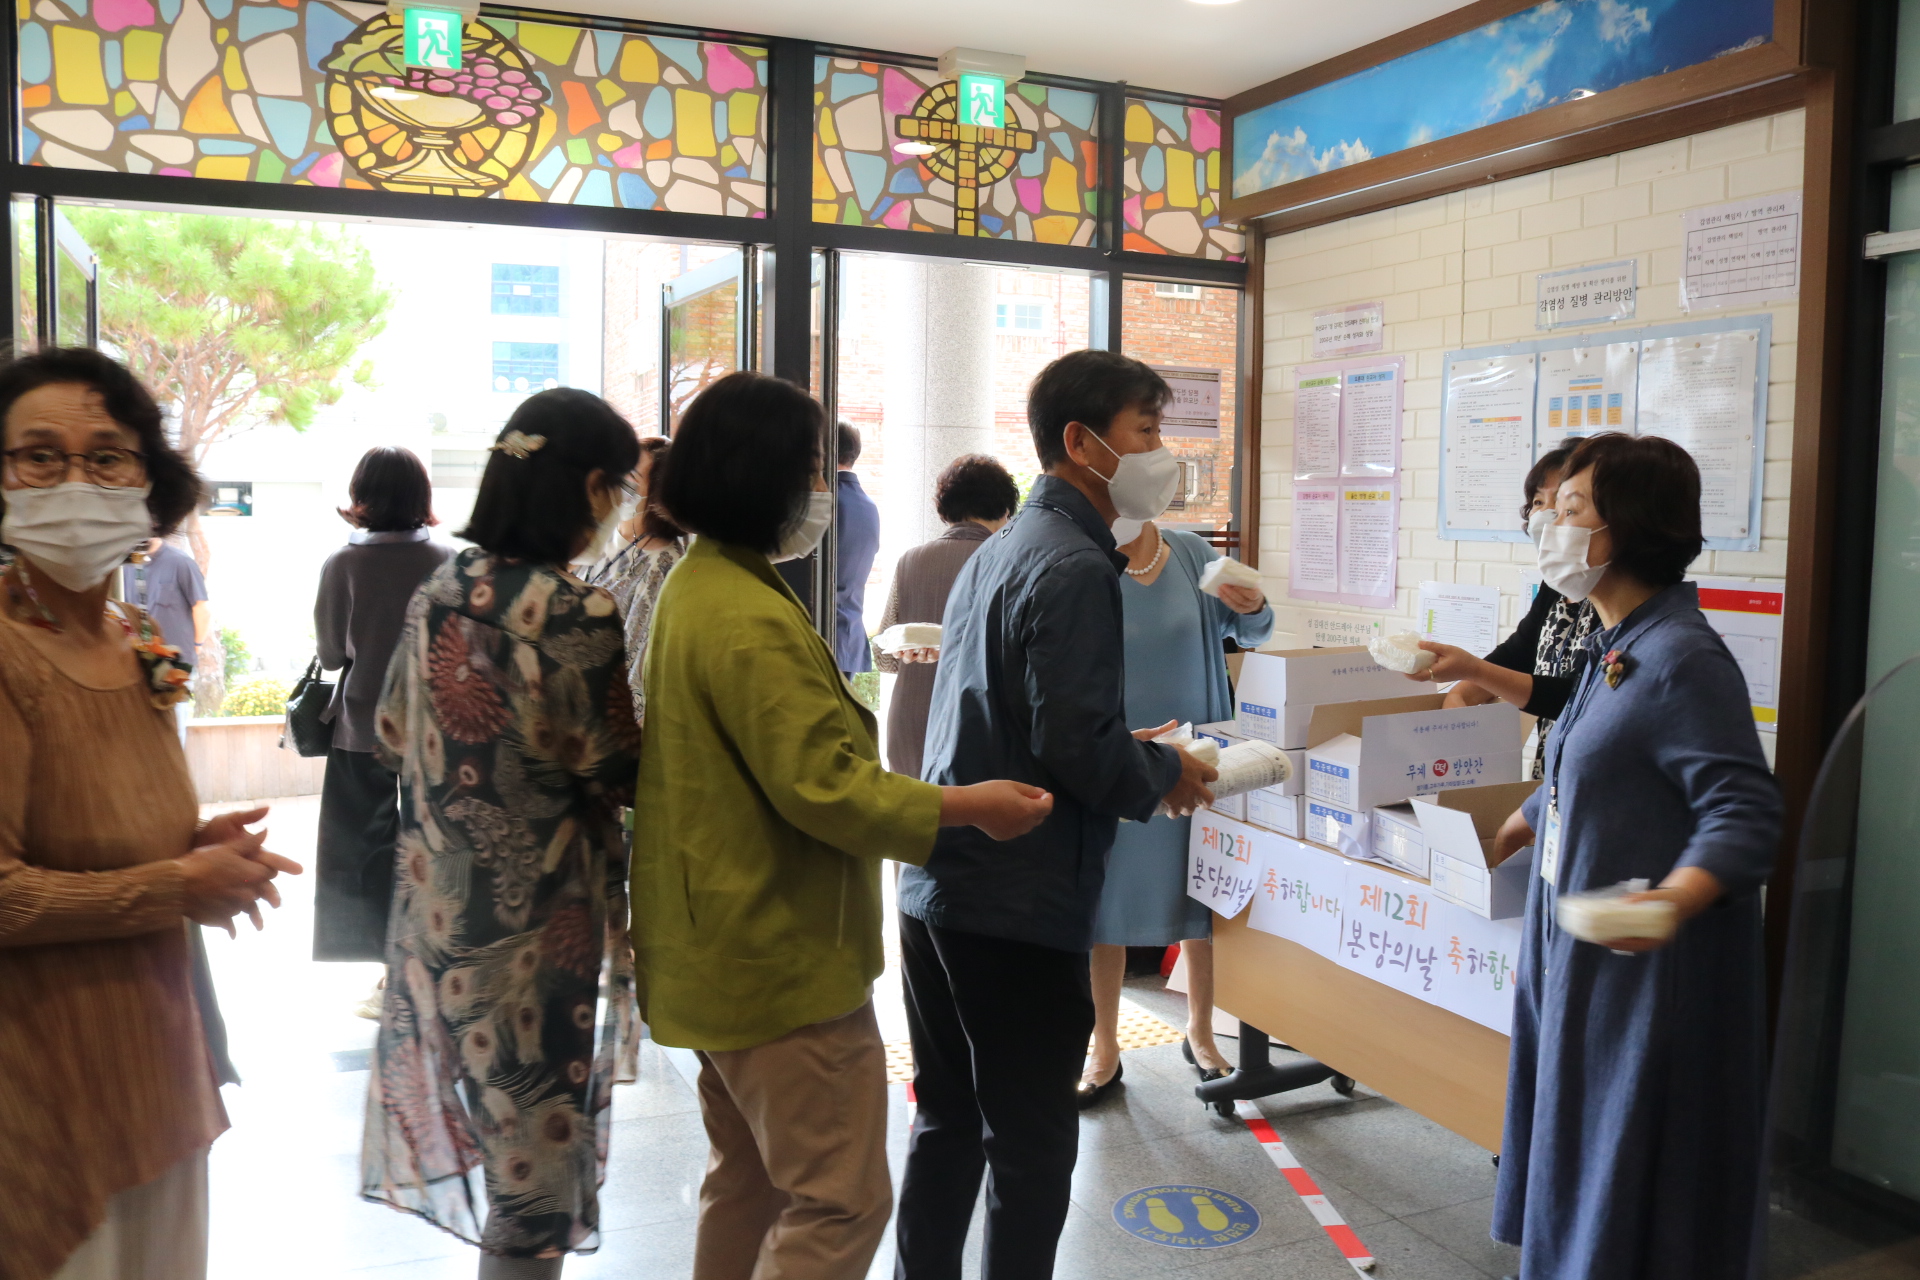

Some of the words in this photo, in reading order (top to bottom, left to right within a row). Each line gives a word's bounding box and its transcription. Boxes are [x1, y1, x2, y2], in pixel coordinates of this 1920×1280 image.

[1767, 204, 1785, 214] 관리자
[1540, 297, 1565, 312] 감염성
[1570, 294, 1588, 308] 질병
[1594, 287, 1632, 305] 관리방안
[1330, 621, 1352, 632] 안드레아
[1354, 624, 1371, 634] 신부님
[1453, 757, 1483, 776] 방앗간
[1202, 827, 1252, 865] 제12회
[1264, 868, 1342, 918] 축하합니다
[1360, 885, 1429, 930] 제12회
[1145, 1187, 1180, 1196] YOUR
[1182, 1188, 1213, 1196] KEEP
[1123, 1193, 1148, 1219] DISTANCE
[1212, 1194, 1245, 1213] PLEASE
[1136, 1227, 1208, 1245] 거리두기
[1211, 1222, 1251, 1243] 안전한
